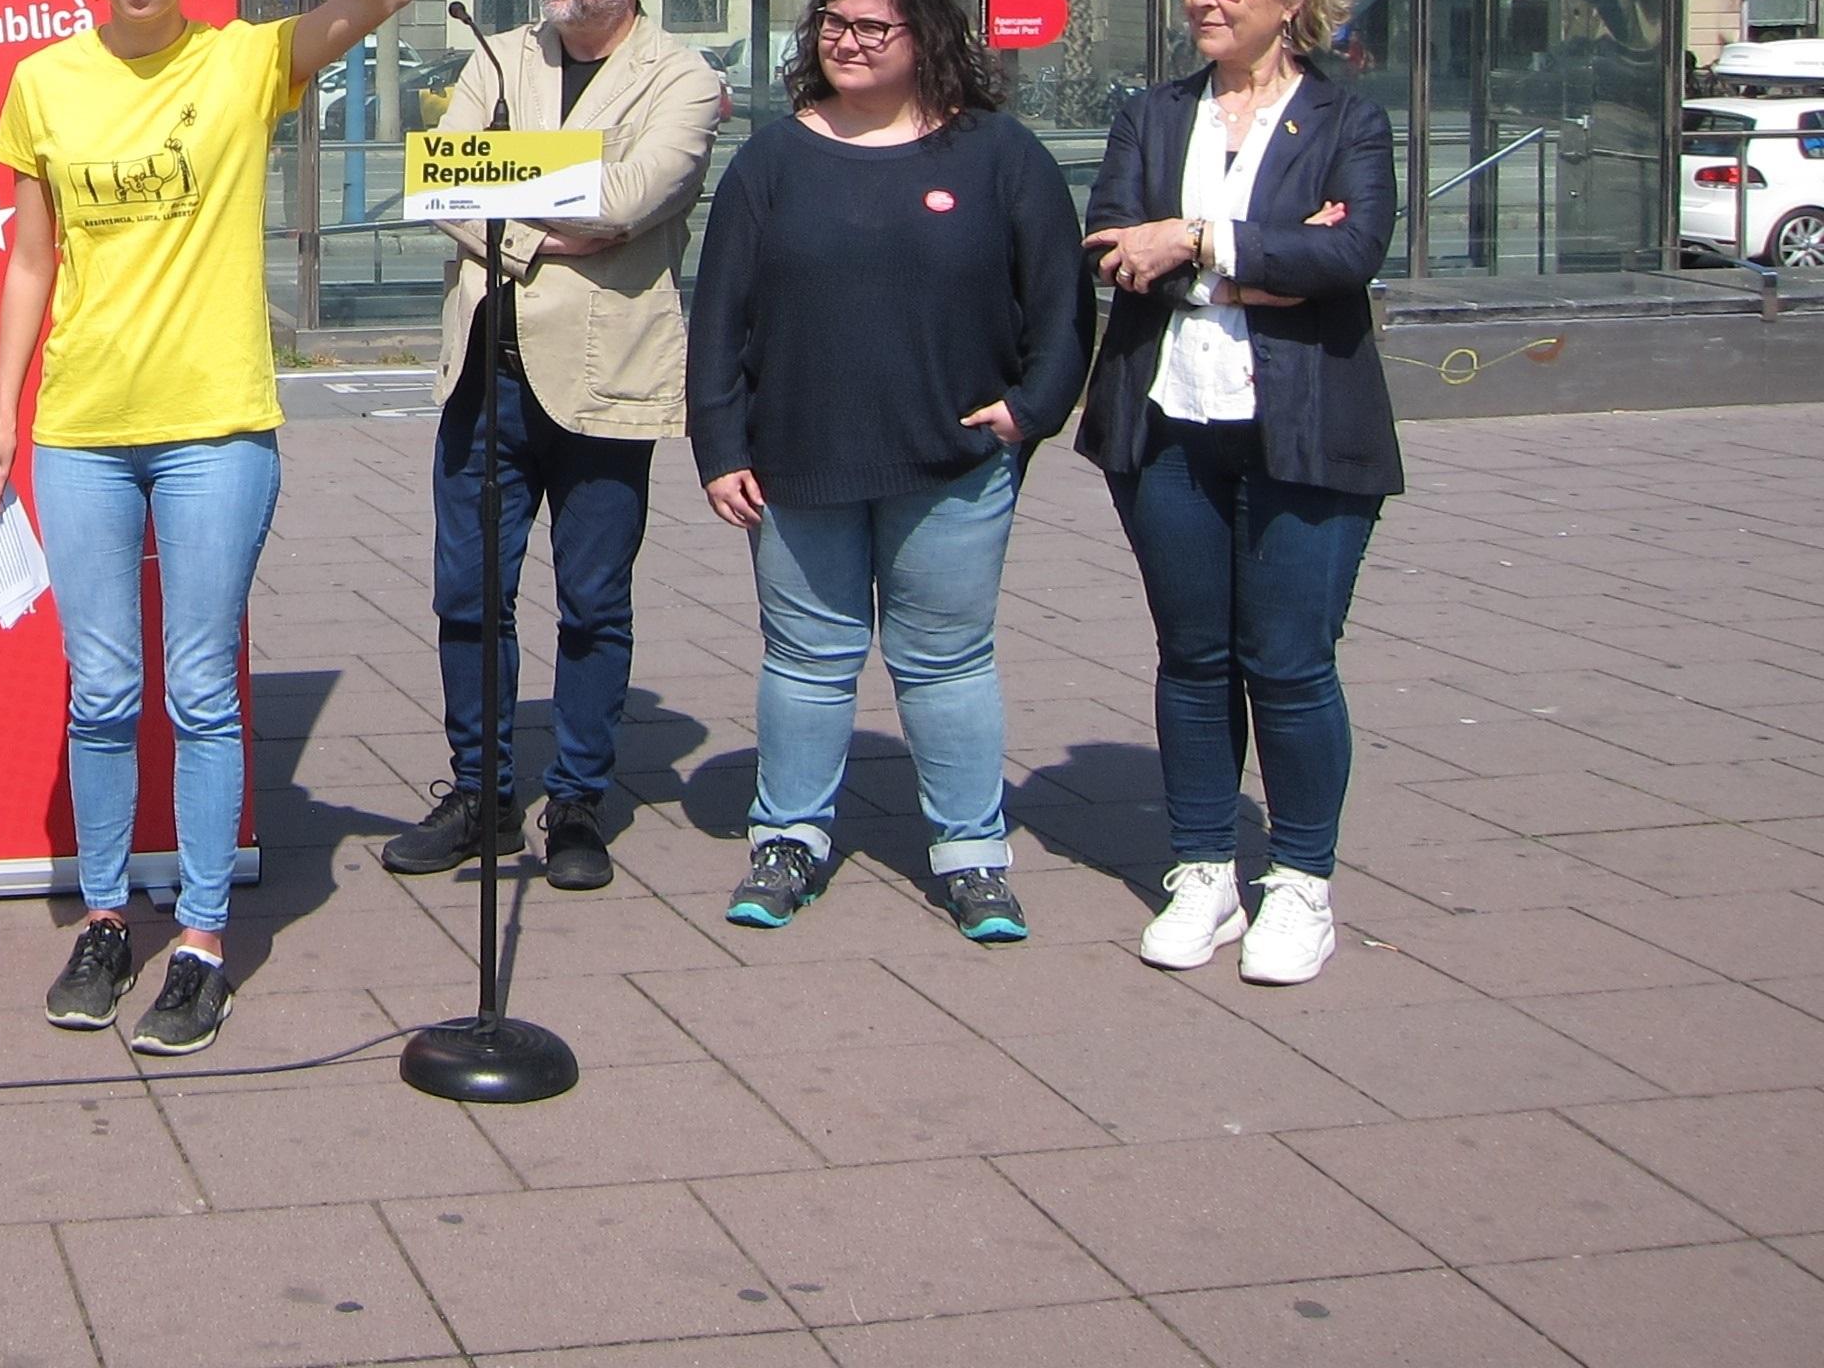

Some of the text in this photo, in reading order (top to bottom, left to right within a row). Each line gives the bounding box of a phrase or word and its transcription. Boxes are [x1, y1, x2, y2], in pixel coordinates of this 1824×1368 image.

[423, 135, 491, 157] Va de
[422, 161, 542, 186] República
